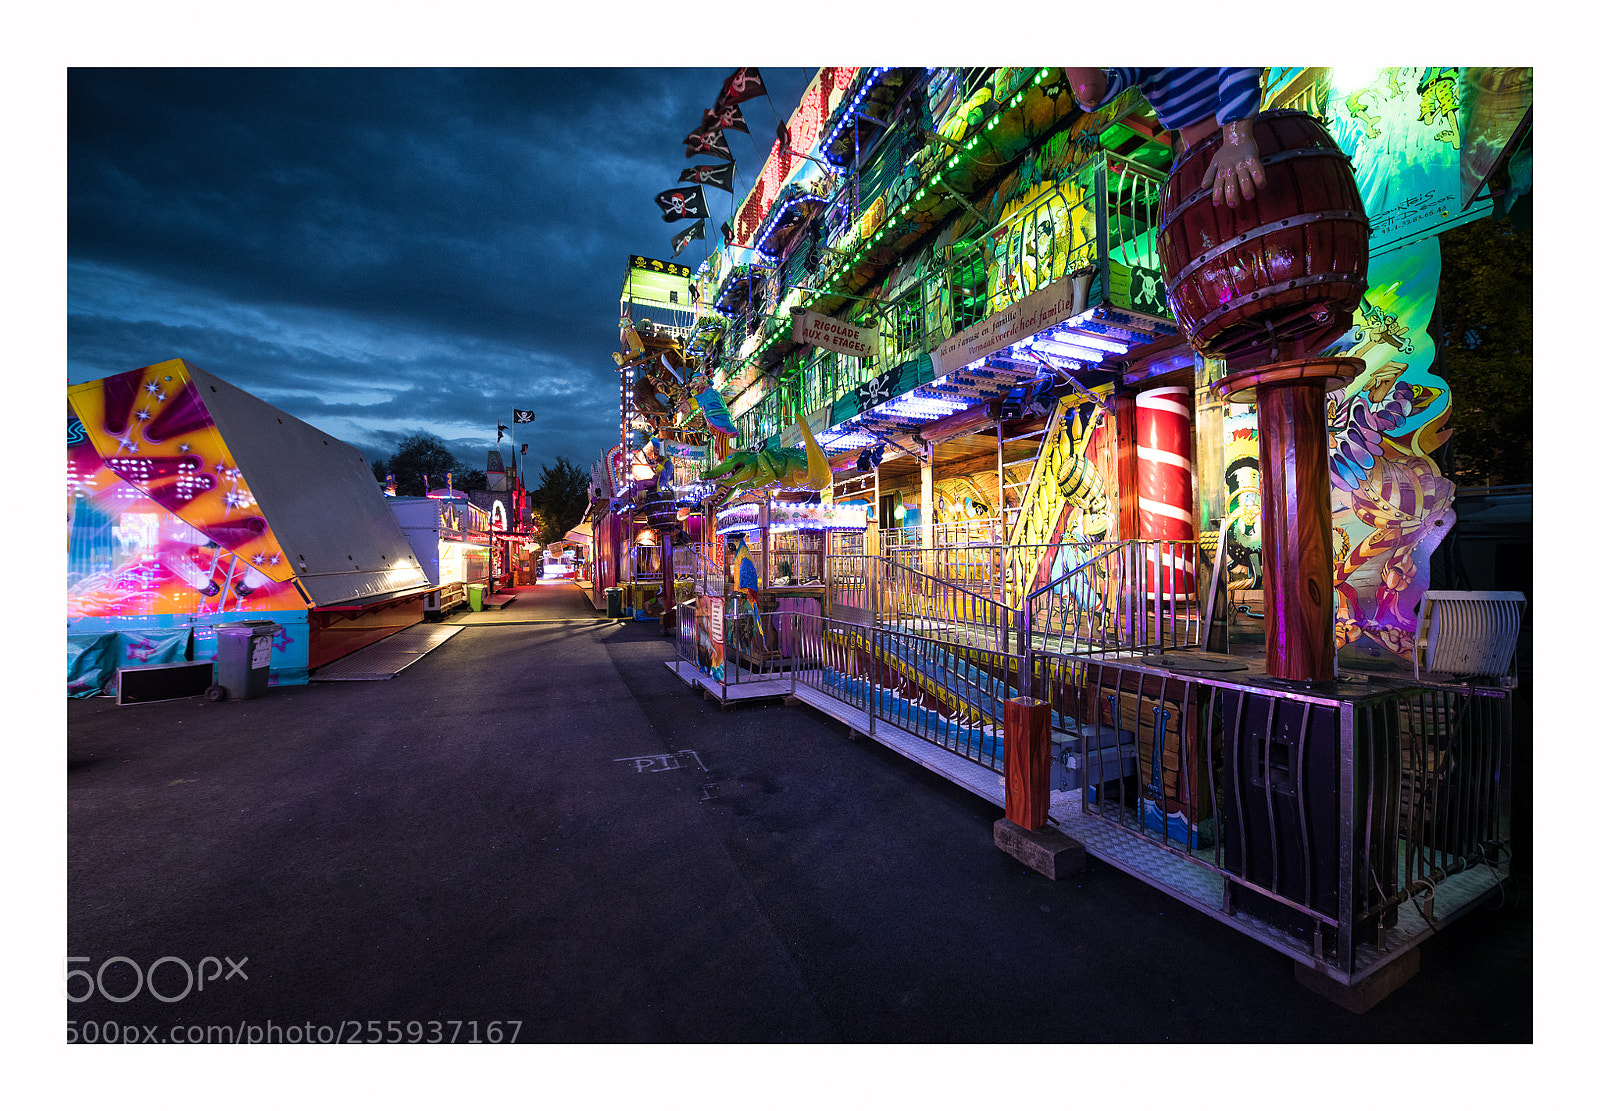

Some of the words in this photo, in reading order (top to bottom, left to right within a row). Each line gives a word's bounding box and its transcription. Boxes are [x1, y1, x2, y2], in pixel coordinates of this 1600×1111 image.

[814, 319, 860, 340] RIGOLADE
[981, 327, 989, 336] en
[991, 310, 1017, 335] famille
[802, 328, 821, 340] AUX
[823, 334, 831, 343] 4
[832, 337, 866, 352] ETAGES
